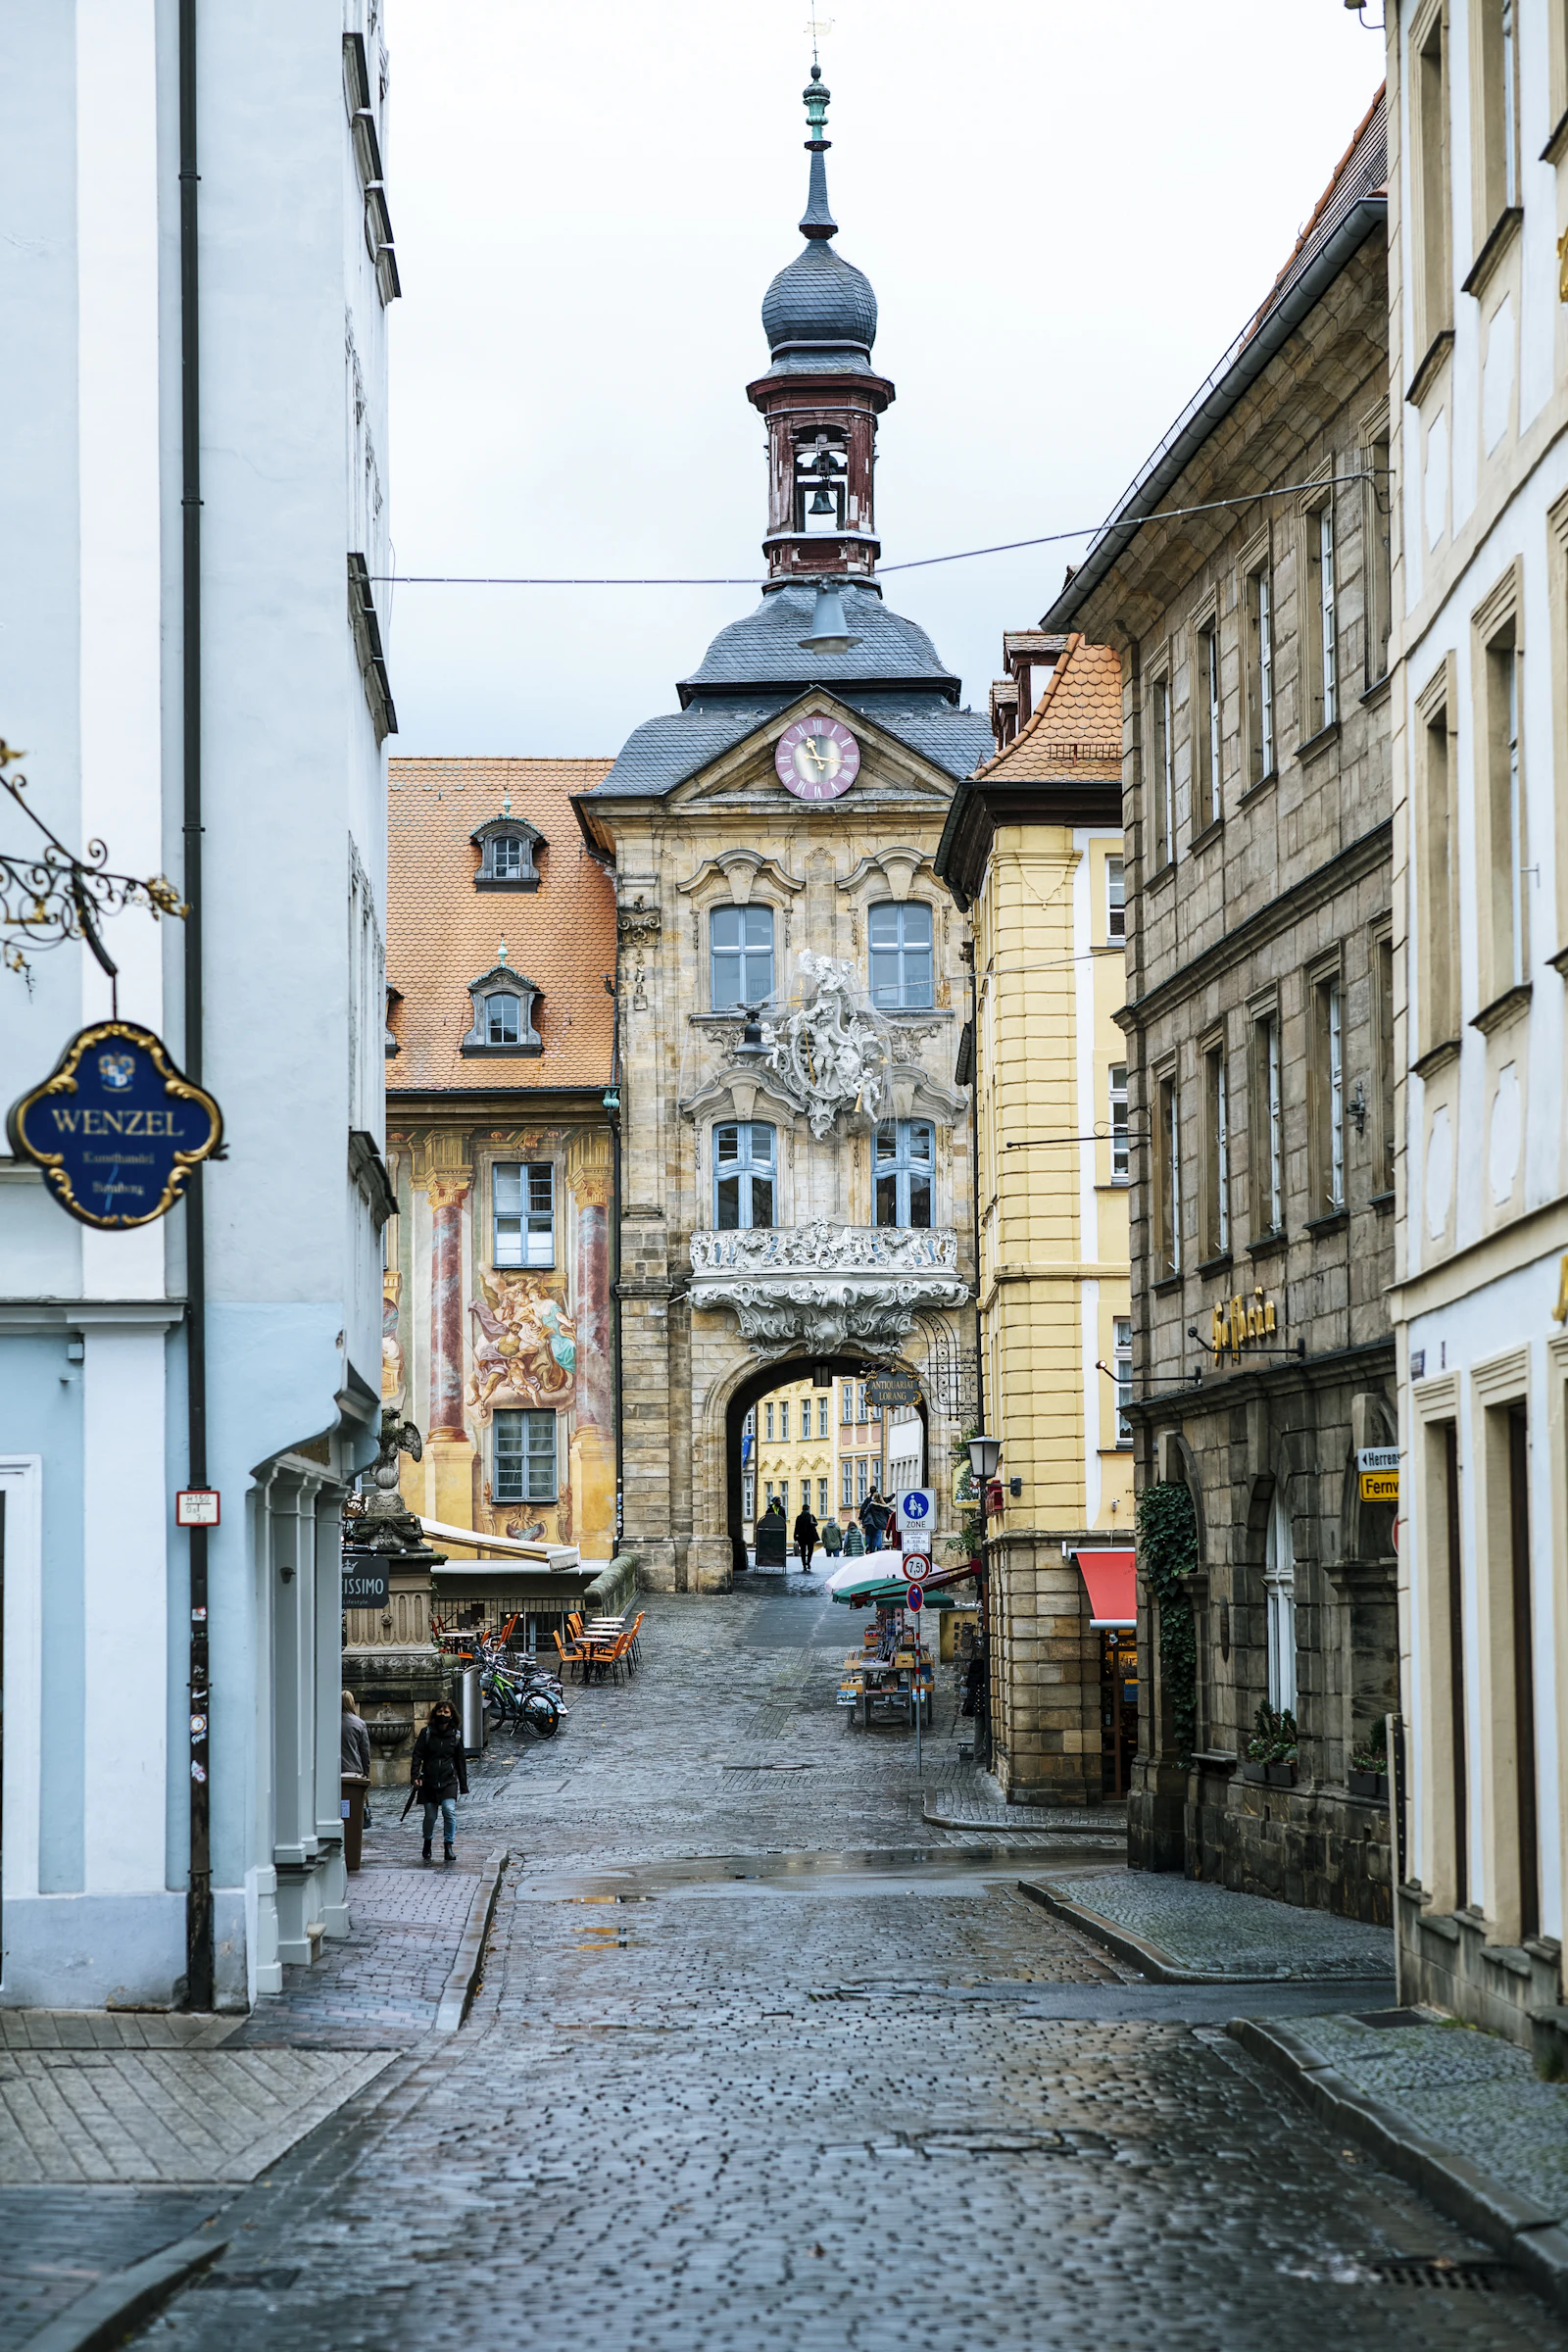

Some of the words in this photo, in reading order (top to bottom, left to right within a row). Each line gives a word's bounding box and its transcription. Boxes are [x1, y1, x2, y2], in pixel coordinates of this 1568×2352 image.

[52, 1108, 184, 1137] WENZEL
[871, 1380, 914, 1391] ANTIQUARIAT
[879, 1392, 906, 1400] LORANG
[906, 1520, 926, 1529] ZONE
[908, 1560, 924, 1576] 7,5t
[342, 1578, 384, 1595] ISSIMO
